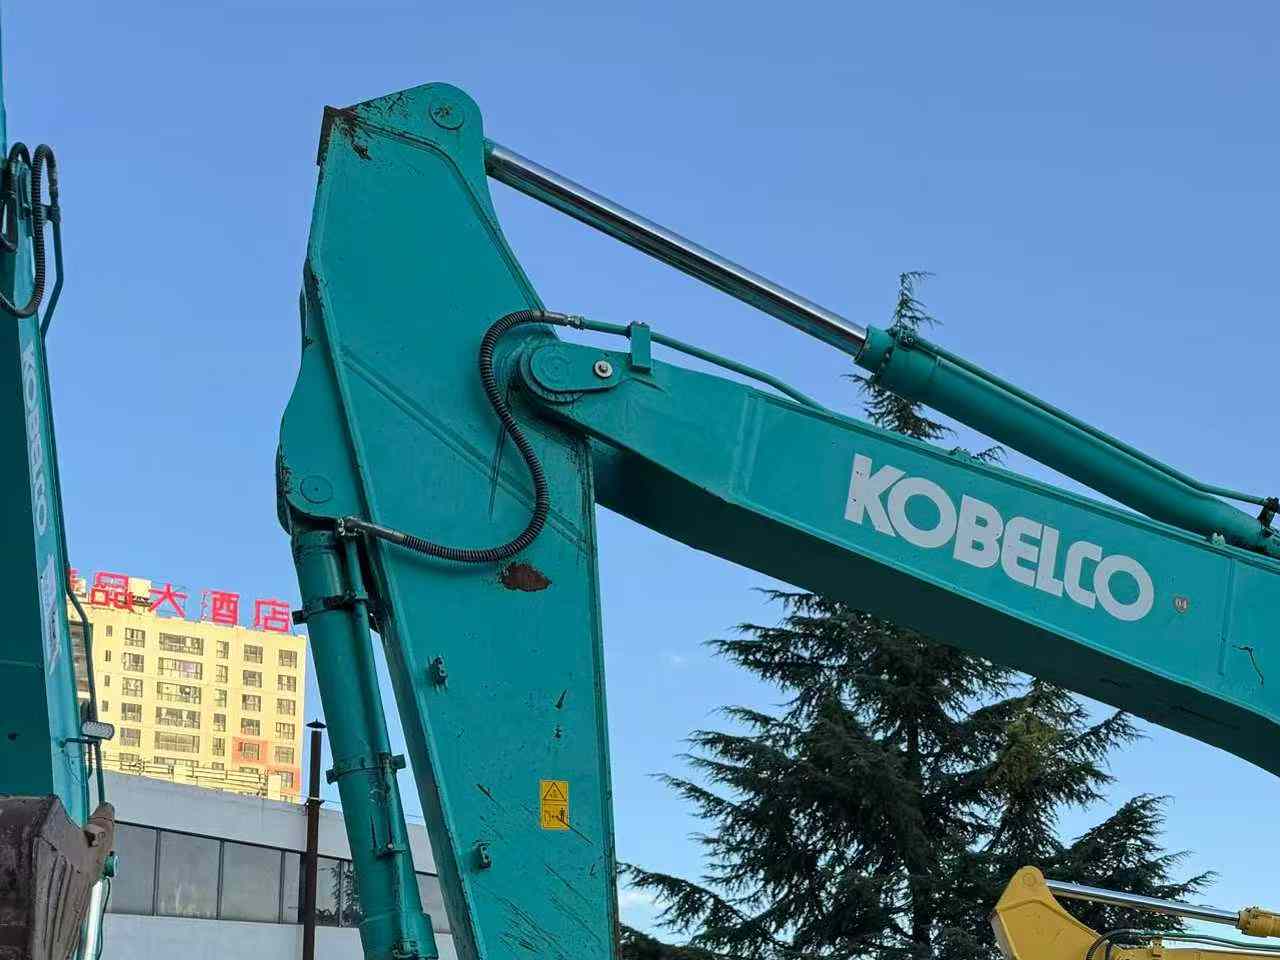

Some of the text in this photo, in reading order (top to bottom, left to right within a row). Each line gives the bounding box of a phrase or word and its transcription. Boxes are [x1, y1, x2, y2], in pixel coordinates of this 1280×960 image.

[843, 453, 1154, 621] KOBELCO
[66, 567, 290, 632] 品大酒店
